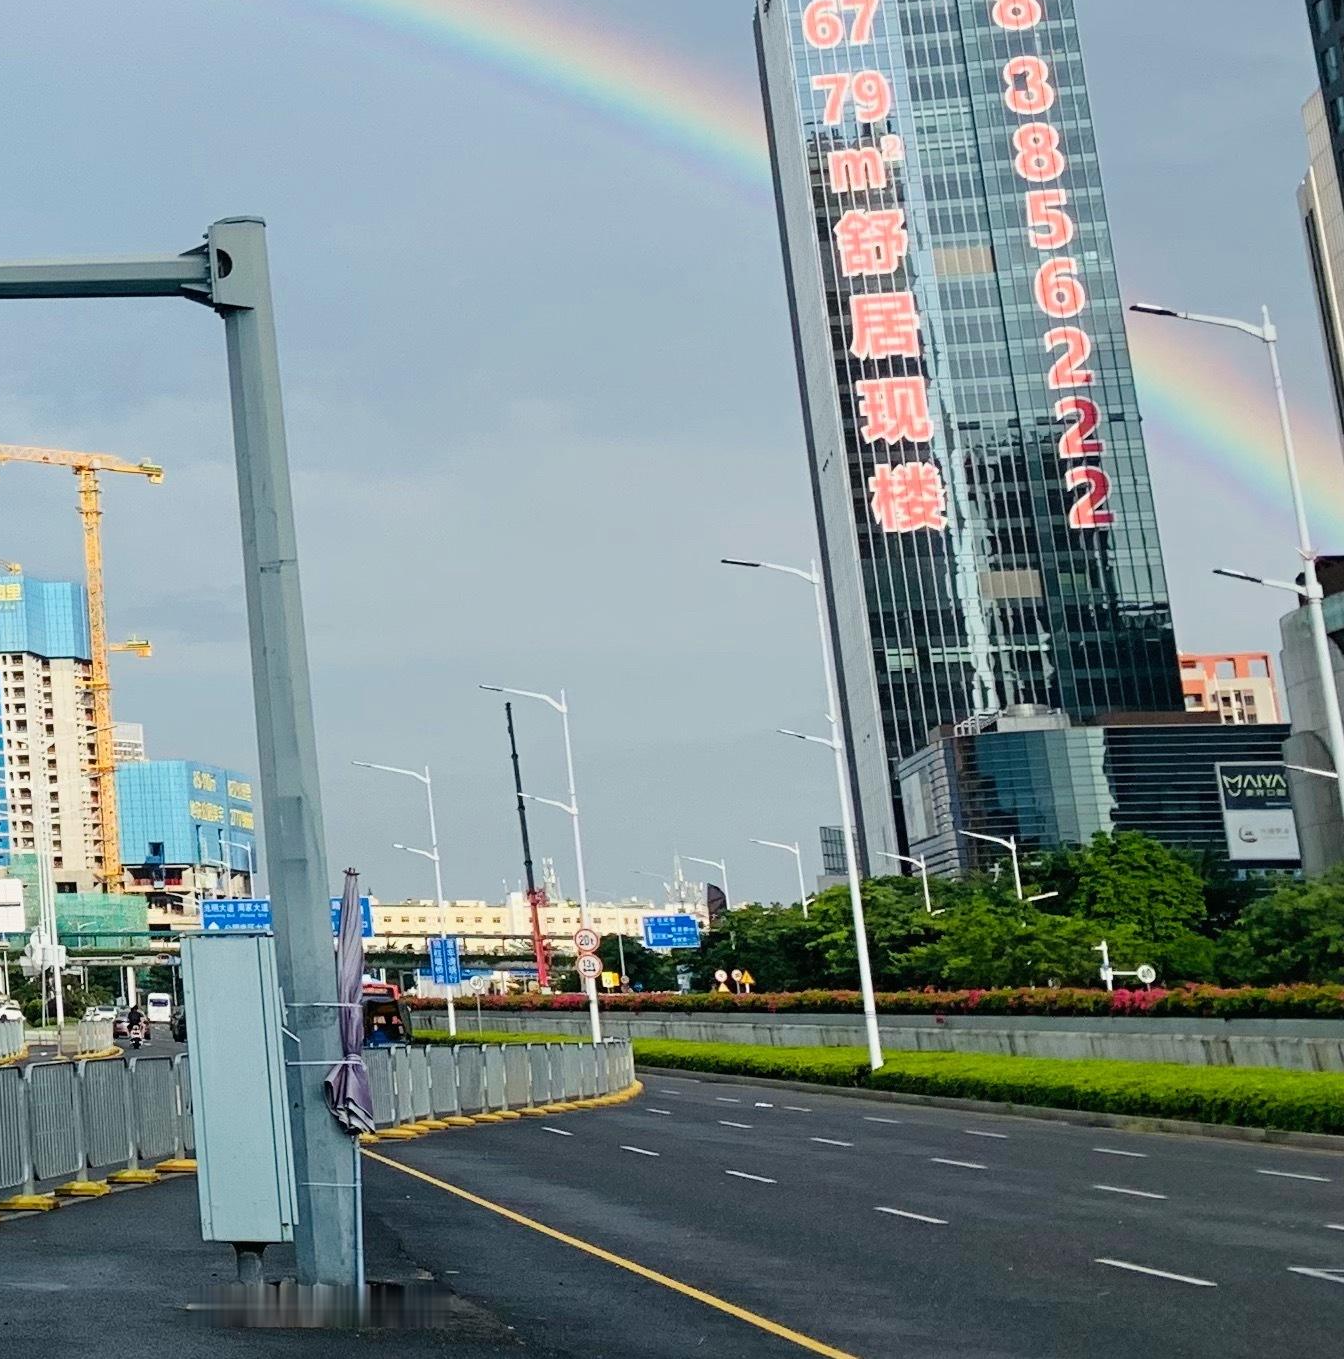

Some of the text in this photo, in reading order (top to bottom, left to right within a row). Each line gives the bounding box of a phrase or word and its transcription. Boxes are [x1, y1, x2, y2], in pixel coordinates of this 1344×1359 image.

[812, 69, 891, 126] 79
[833, 208, 948, 533] 舒居现楼
[1222, 774, 1287, 792] MAIYA
